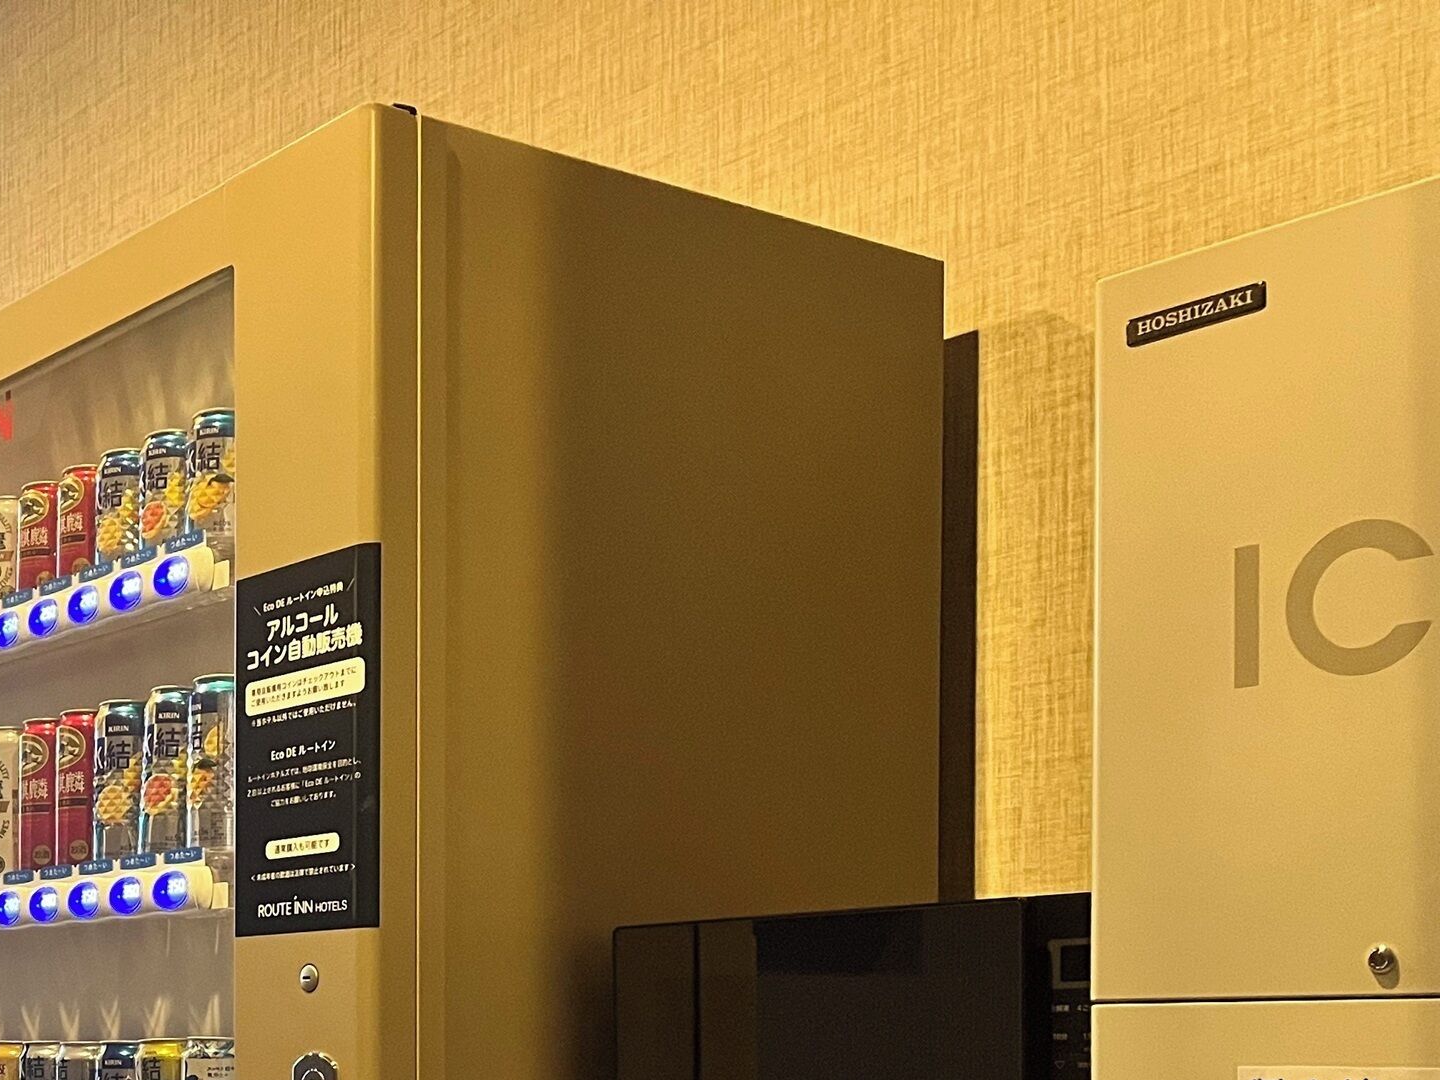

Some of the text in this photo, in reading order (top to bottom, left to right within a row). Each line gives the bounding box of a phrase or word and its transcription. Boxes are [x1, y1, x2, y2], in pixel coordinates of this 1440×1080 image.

[1137, 289, 1254, 336] HOSHIZAKI
[263, 602, 275, 613] Eco
[276, 598, 285, 609] DE
[1233, 518, 1435, 689] IC
[266, 603, 339, 642] アルコール
[246, 622, 363, 671] コイン自動販売機
[158, 712, 180, 720] KIRIN
[108, 725, 130, 733] KIRIN
[271, 740, 336, 761] Eco DE ルートイン
[258, 901, 292, 918] ROUTE
[315, 900, 348, 912] HOTELS
